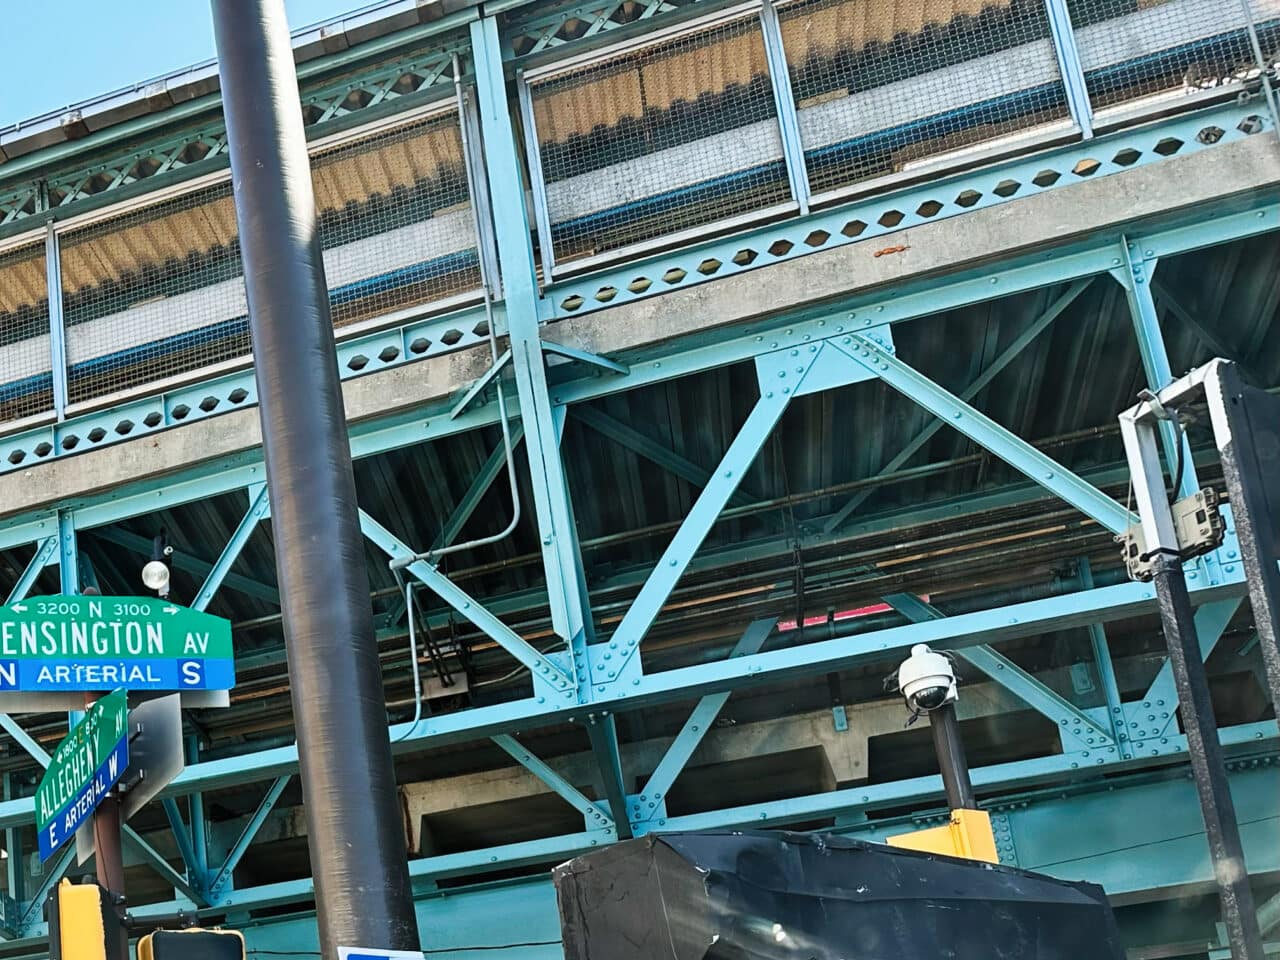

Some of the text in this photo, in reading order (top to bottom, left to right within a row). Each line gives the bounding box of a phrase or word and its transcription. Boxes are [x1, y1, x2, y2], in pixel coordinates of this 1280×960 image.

[37, 601, 151, 618] 3200 N 3100
[183, 632, 210, 654] AV
[37, 664, 161, 683] ARTERIAL
[181, 661, 201, 685] S
[78, 726, 84, 743] E
[41, 706, 124, 825] ALLEGHENY AV
[49, 750, 118, 849] E ARTERIAL W
